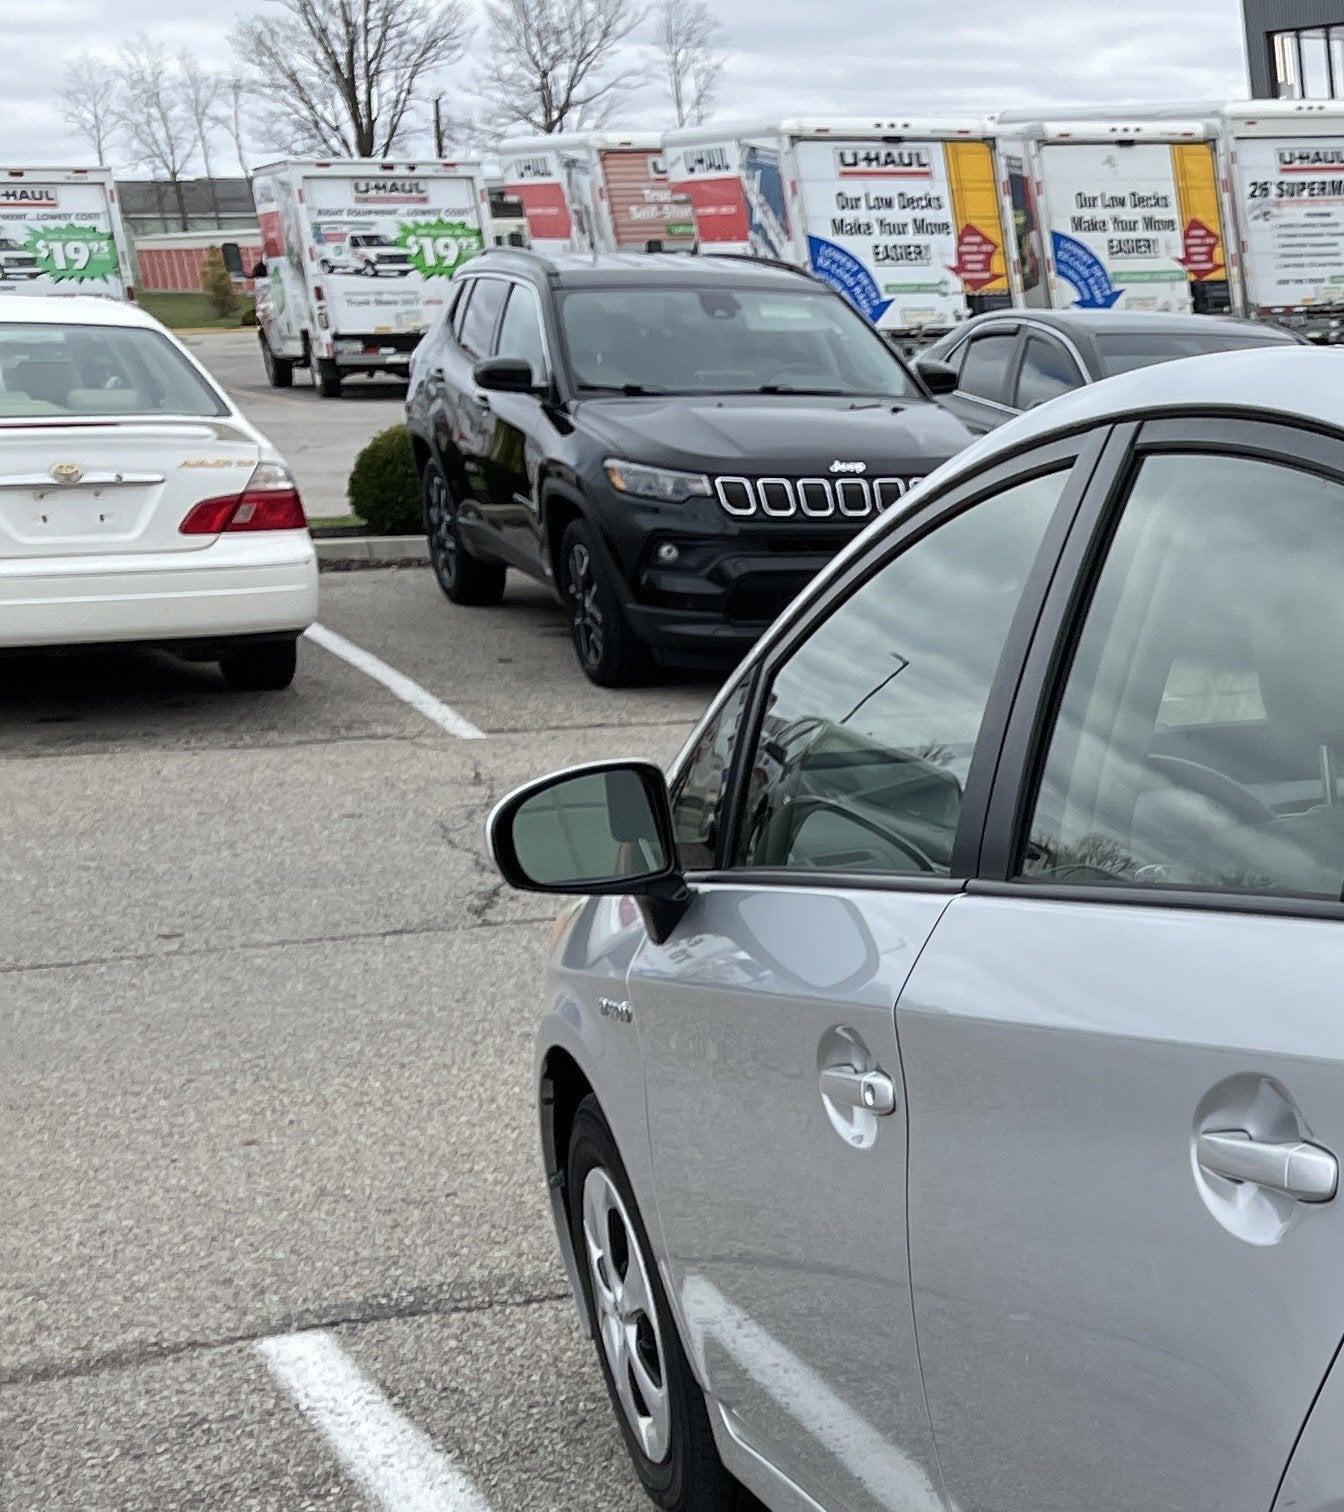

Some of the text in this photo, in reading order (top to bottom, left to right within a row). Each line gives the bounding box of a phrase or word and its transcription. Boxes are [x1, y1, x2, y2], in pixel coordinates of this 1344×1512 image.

[839, 151, 930, 168] U-HAUL
[0, 190, 56, 201] -HAUL
[354, 181, 427, 194] U-HAUL
[834, 191, 943, 211] Our Low Decks
[1075, 191, 1170, 210] Our Low Decks
[832, 217, 951, 236] Make Your Move
[1070, 216, 1177, 233] Make Your Move
[829, 460, 866, 473] Jeep
